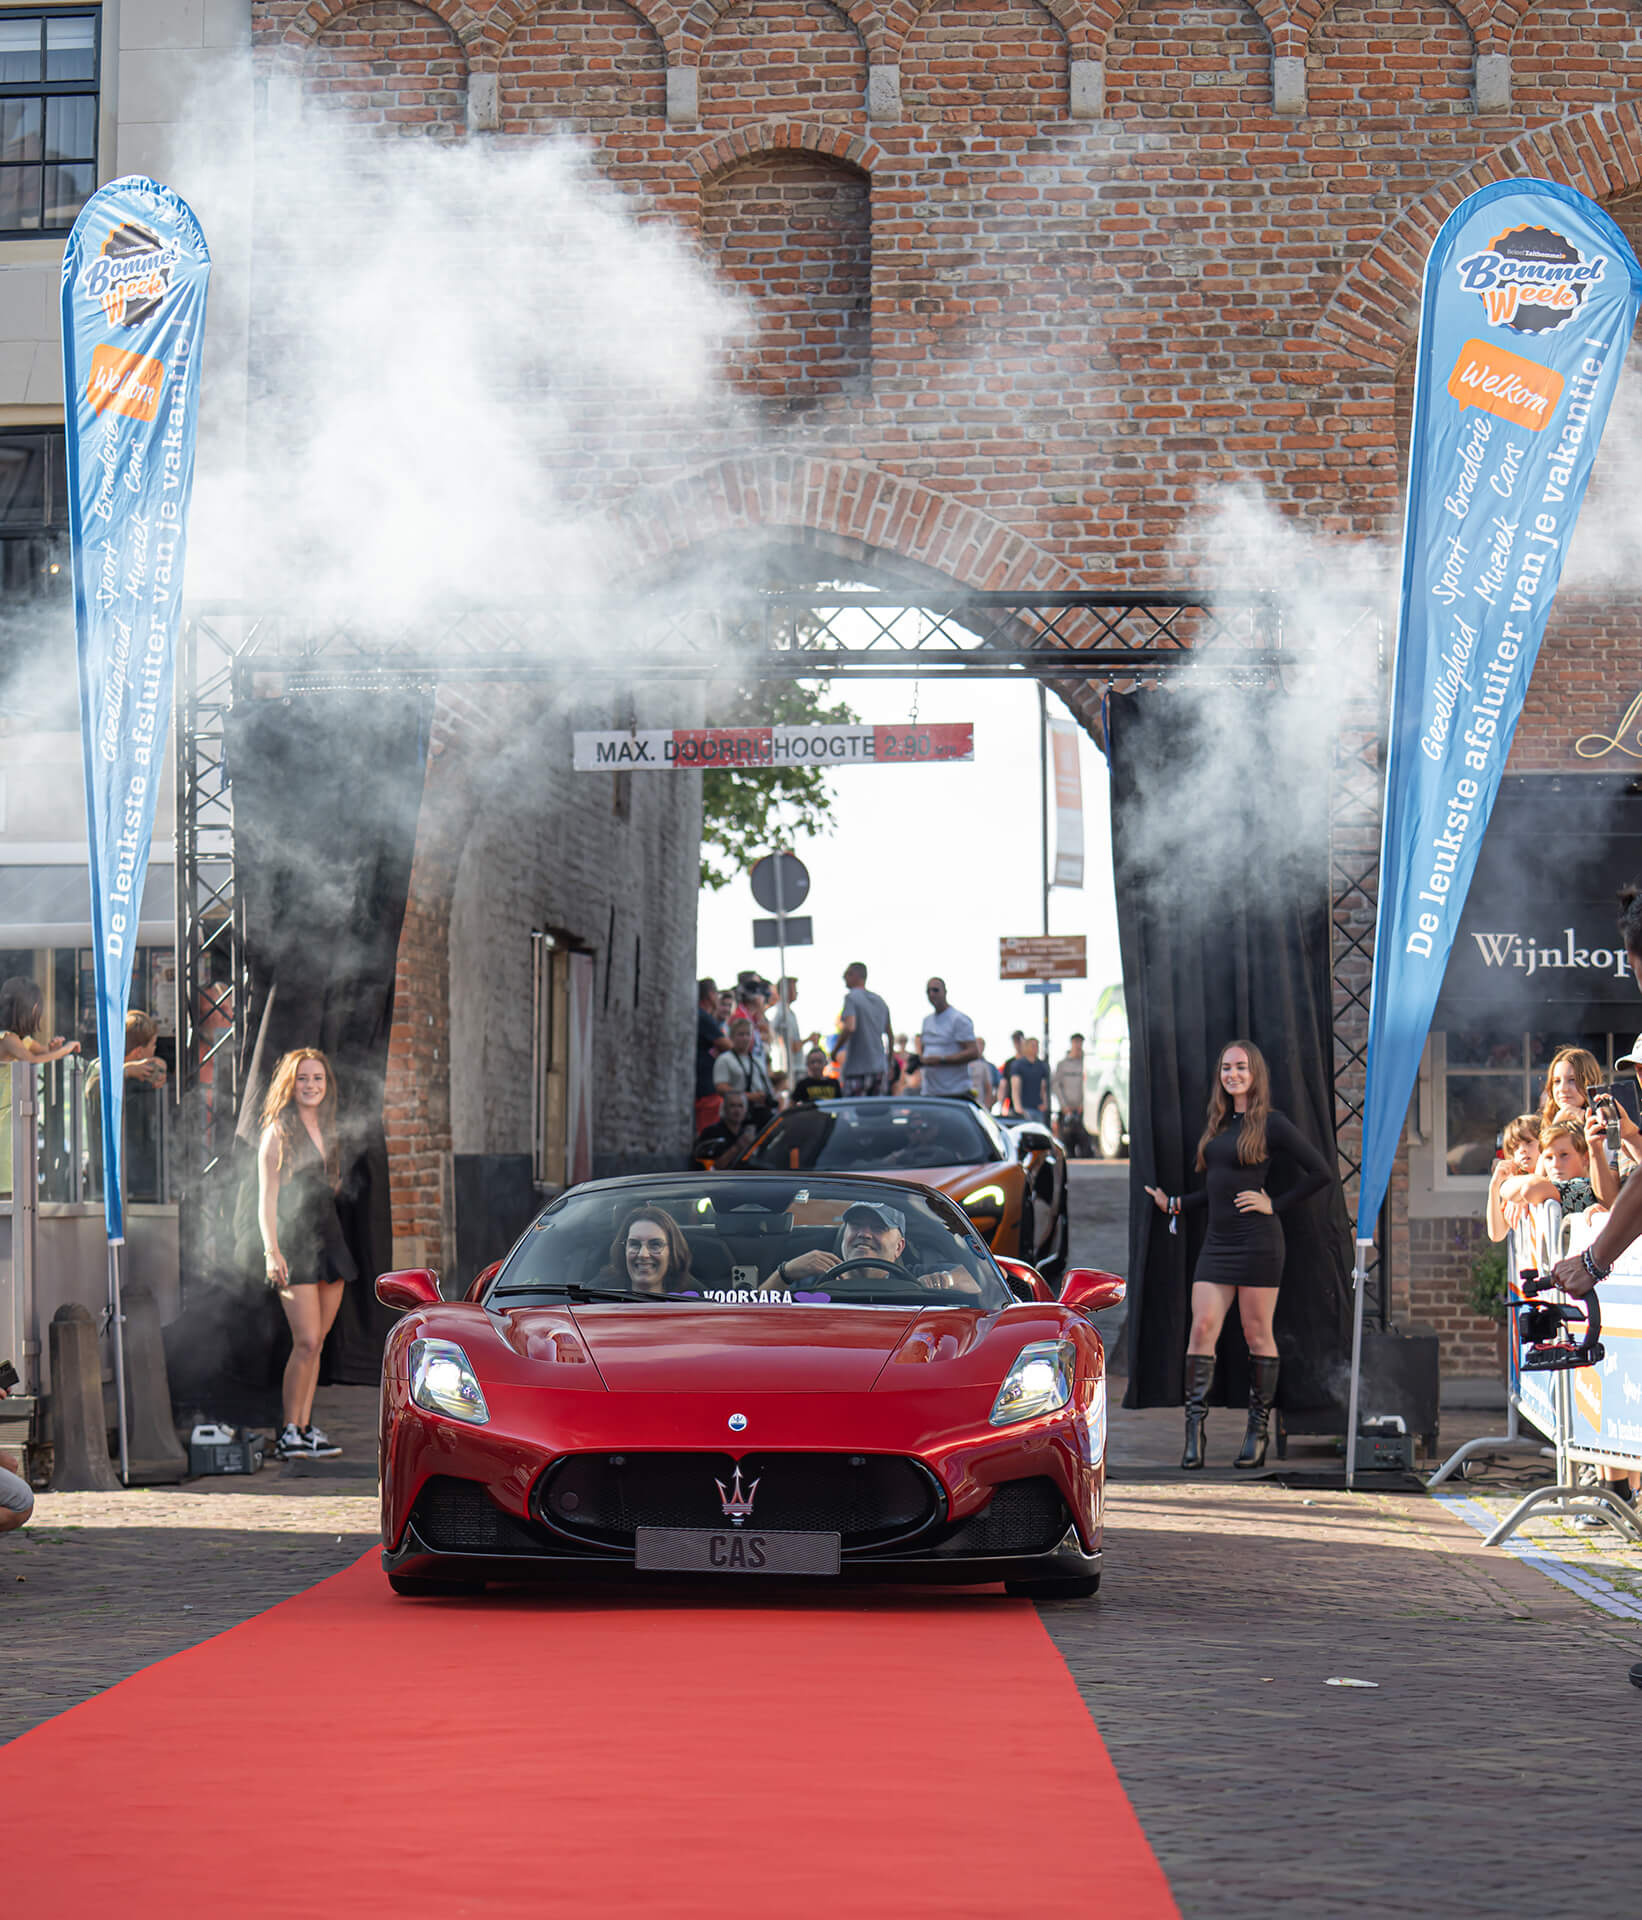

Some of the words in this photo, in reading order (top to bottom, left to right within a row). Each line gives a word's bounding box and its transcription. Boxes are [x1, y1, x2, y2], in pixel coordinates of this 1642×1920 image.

[105, 272, 164, 323] Week
[1461, 255, 1604, 289] Bommel
[1488, 284, 1574, 322] Week
[1460, 361, 1549, 416] Welkom
[94, 419, 118, 522] Braderie
[123, 438, 144, 493] Cars
[1444, 417, 1493, 521] Braderie
[1489, 442, 1525, 499] Cars
[156, 502, 181, 537] je
[1526, 512, 1557, 549] je
[96, 537, 119, 608] Sport
[123, 512, 150, 602] Muziek
[152, 542, 174, 604] van
[1431, 535, 1469, 607] Sport
[1473, 515, 1520, 606] Muziek
[1510, 551, 1545, 612] van
[100, 616, 134, 763] Gezelligheid
[133, 614, 168, 766] afsluiter
[1420, 614, 1478, 762] Gezelligheid
[1465, 622, 1523, 772] afsluiter
[596, 740, 655, 763] MAX.
[884, 735, 930, 757] 2.90
[110, 775, 146, 904] leukste
[1418, 778, 1478, 905] leukste
[106, 914, 125, 958] De
[1406, 912, 1439, 960] De
[709, 1536, 766, 1567] CAS
